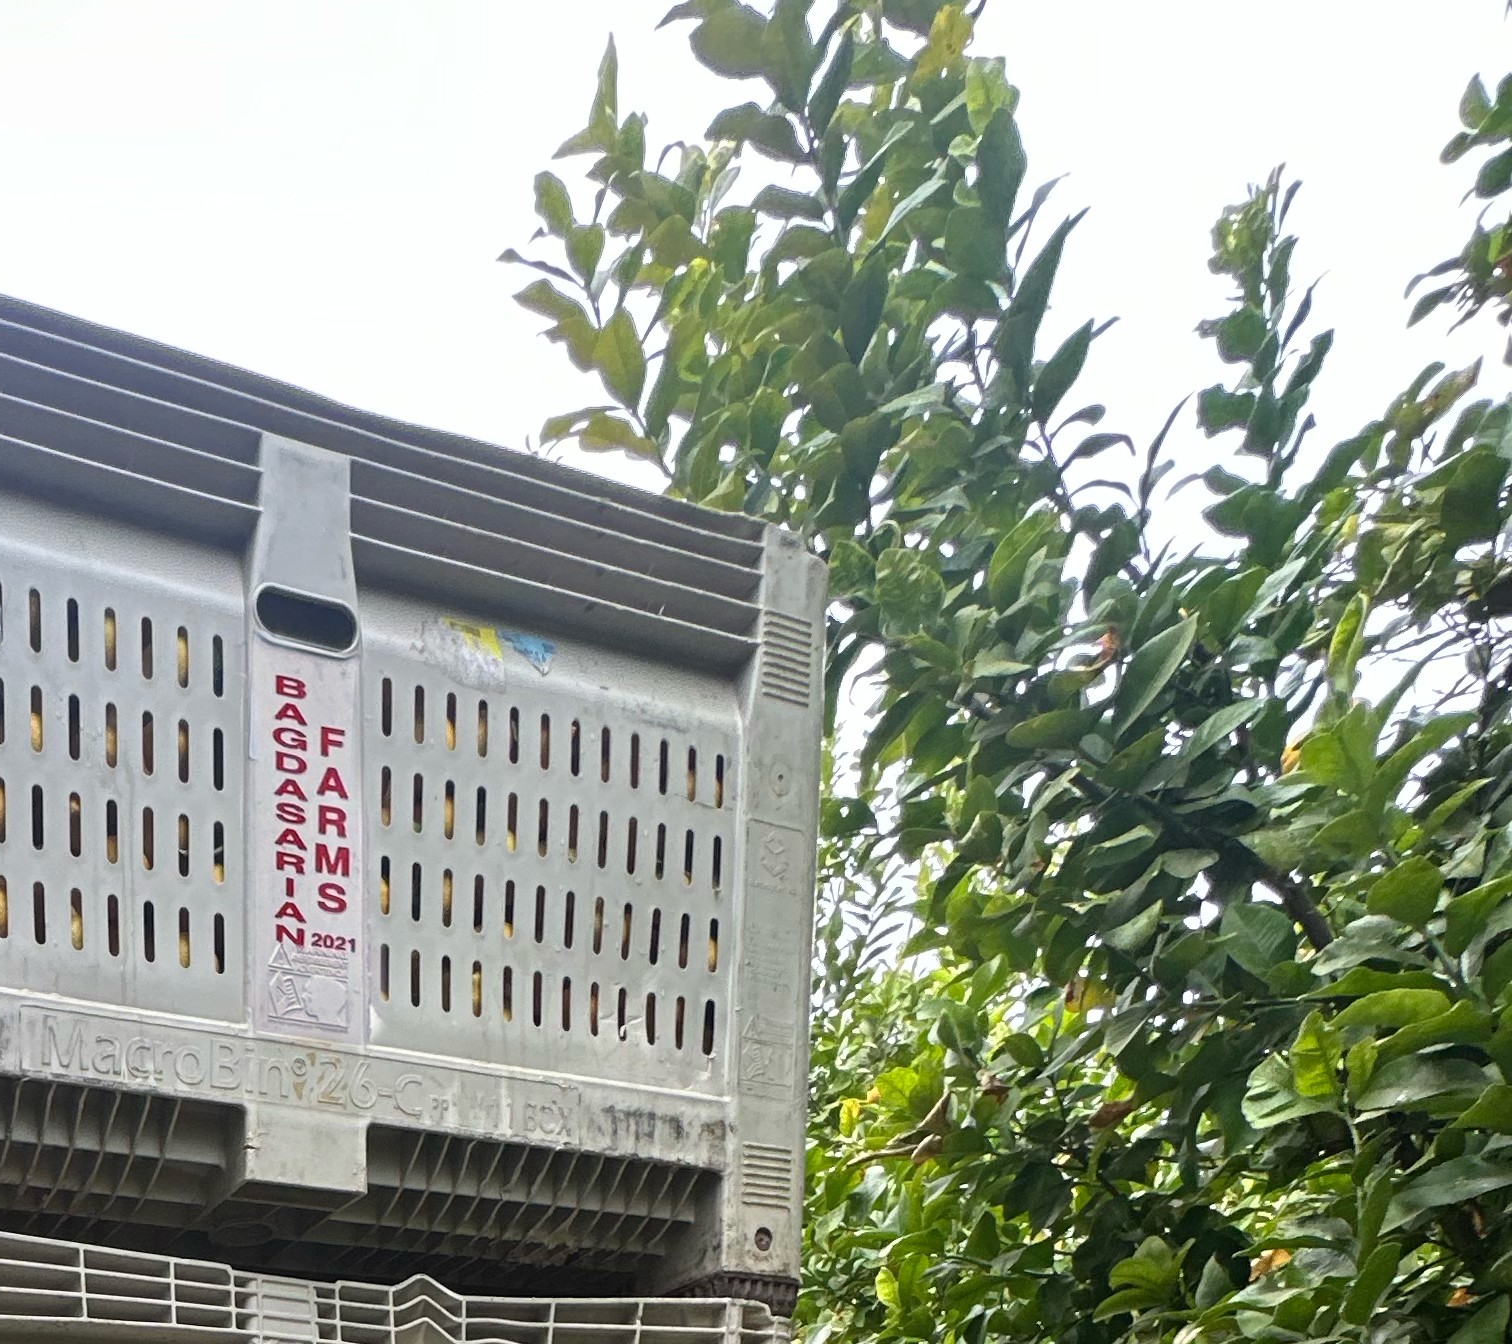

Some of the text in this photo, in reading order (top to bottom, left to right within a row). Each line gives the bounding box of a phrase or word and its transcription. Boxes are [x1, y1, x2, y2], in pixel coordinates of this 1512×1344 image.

[272, 675, 308, 948] BAGDASARIAN
[314, 725, 351, 914] FARMS
[311, 932, 356, 953] 2021
